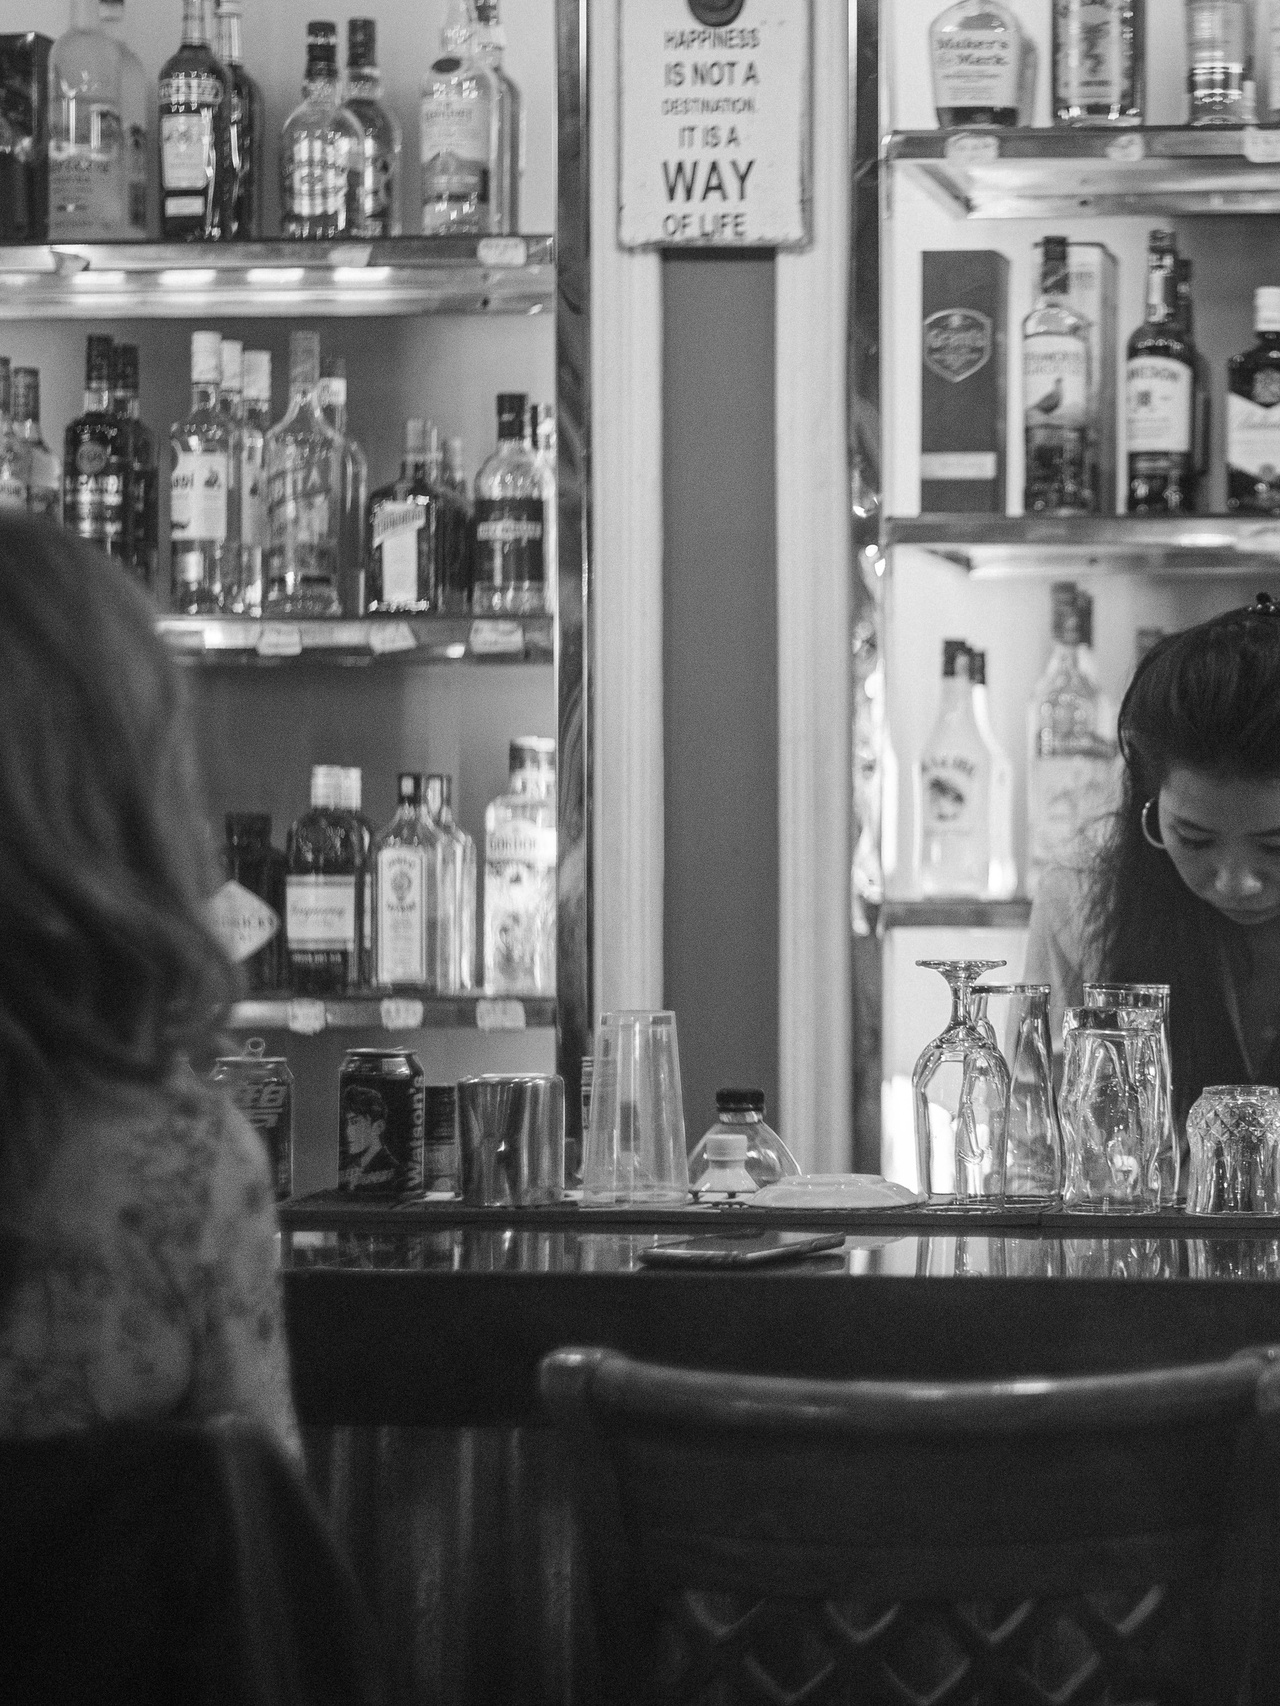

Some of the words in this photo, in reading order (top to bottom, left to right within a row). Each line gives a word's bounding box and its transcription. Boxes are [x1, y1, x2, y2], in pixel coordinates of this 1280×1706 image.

[664, 28, 760, 50] HAPPINESS
[664, 62, 685, 87] IS
[692, 61, 737, 86] NOT
[742, 61, 760, 85] A
[678, 126, 696, 148] IT
[702, 126, 720, 148] IS
[724, 125, 741, 147] A
[662, 159, 756, 202] WAY
[662, 213, 694, 238] OF
[698, 211, 747, 237] LIFE
[407, 1075, 425, 1188] Watson's
